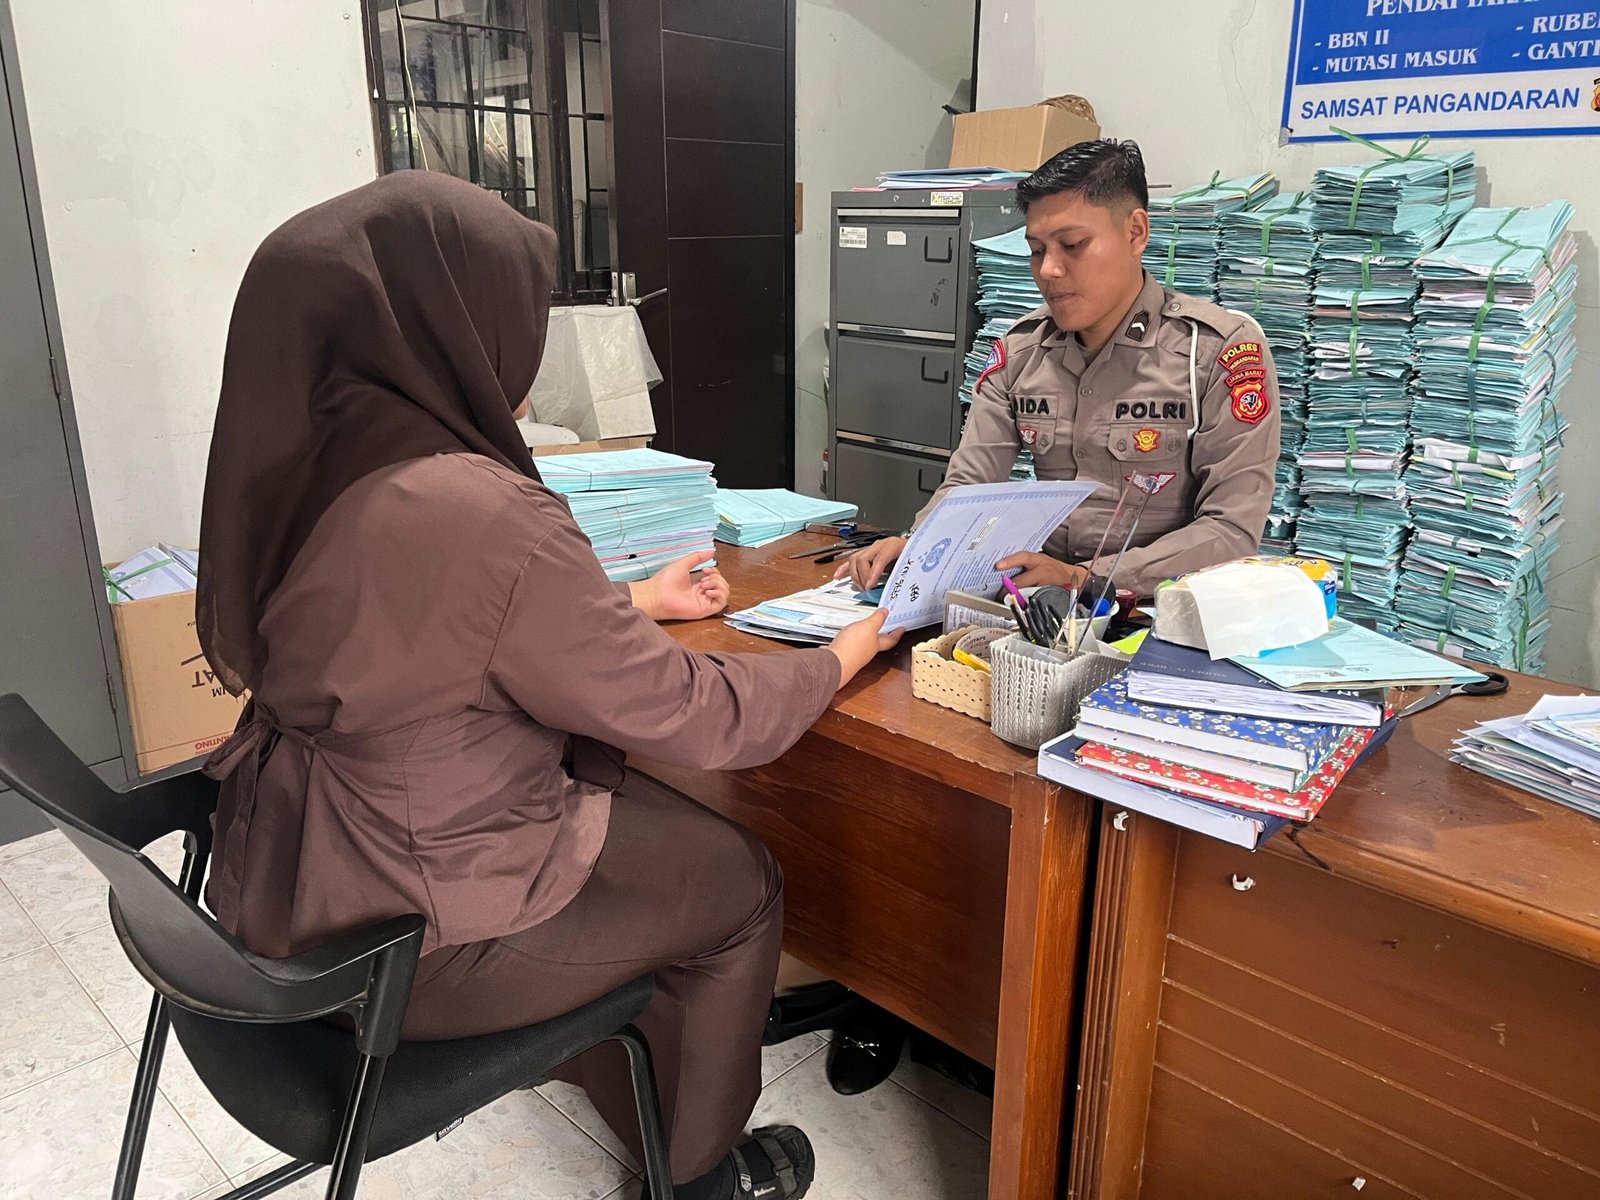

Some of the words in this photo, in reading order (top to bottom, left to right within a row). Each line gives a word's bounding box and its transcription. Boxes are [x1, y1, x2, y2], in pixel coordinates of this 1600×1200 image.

[1531, 12, 1600, 33] RUBE
[1328, 31, 1368, 49] BBN
[1375, 29, 1389, 45] II
[1325, 53, 1397, 74] MUTASI
[1404, 48, 1478, 68] MASUK
[1301, 97, 1388, 119] SAMSAT
[1394, 87, 1580, 114] PANGANDARAN
[1222, 343, 1258, 362] POLRES
[1014, 397, 1049, 415] IDA
[1115, 401, 1186, 419] POLRI
